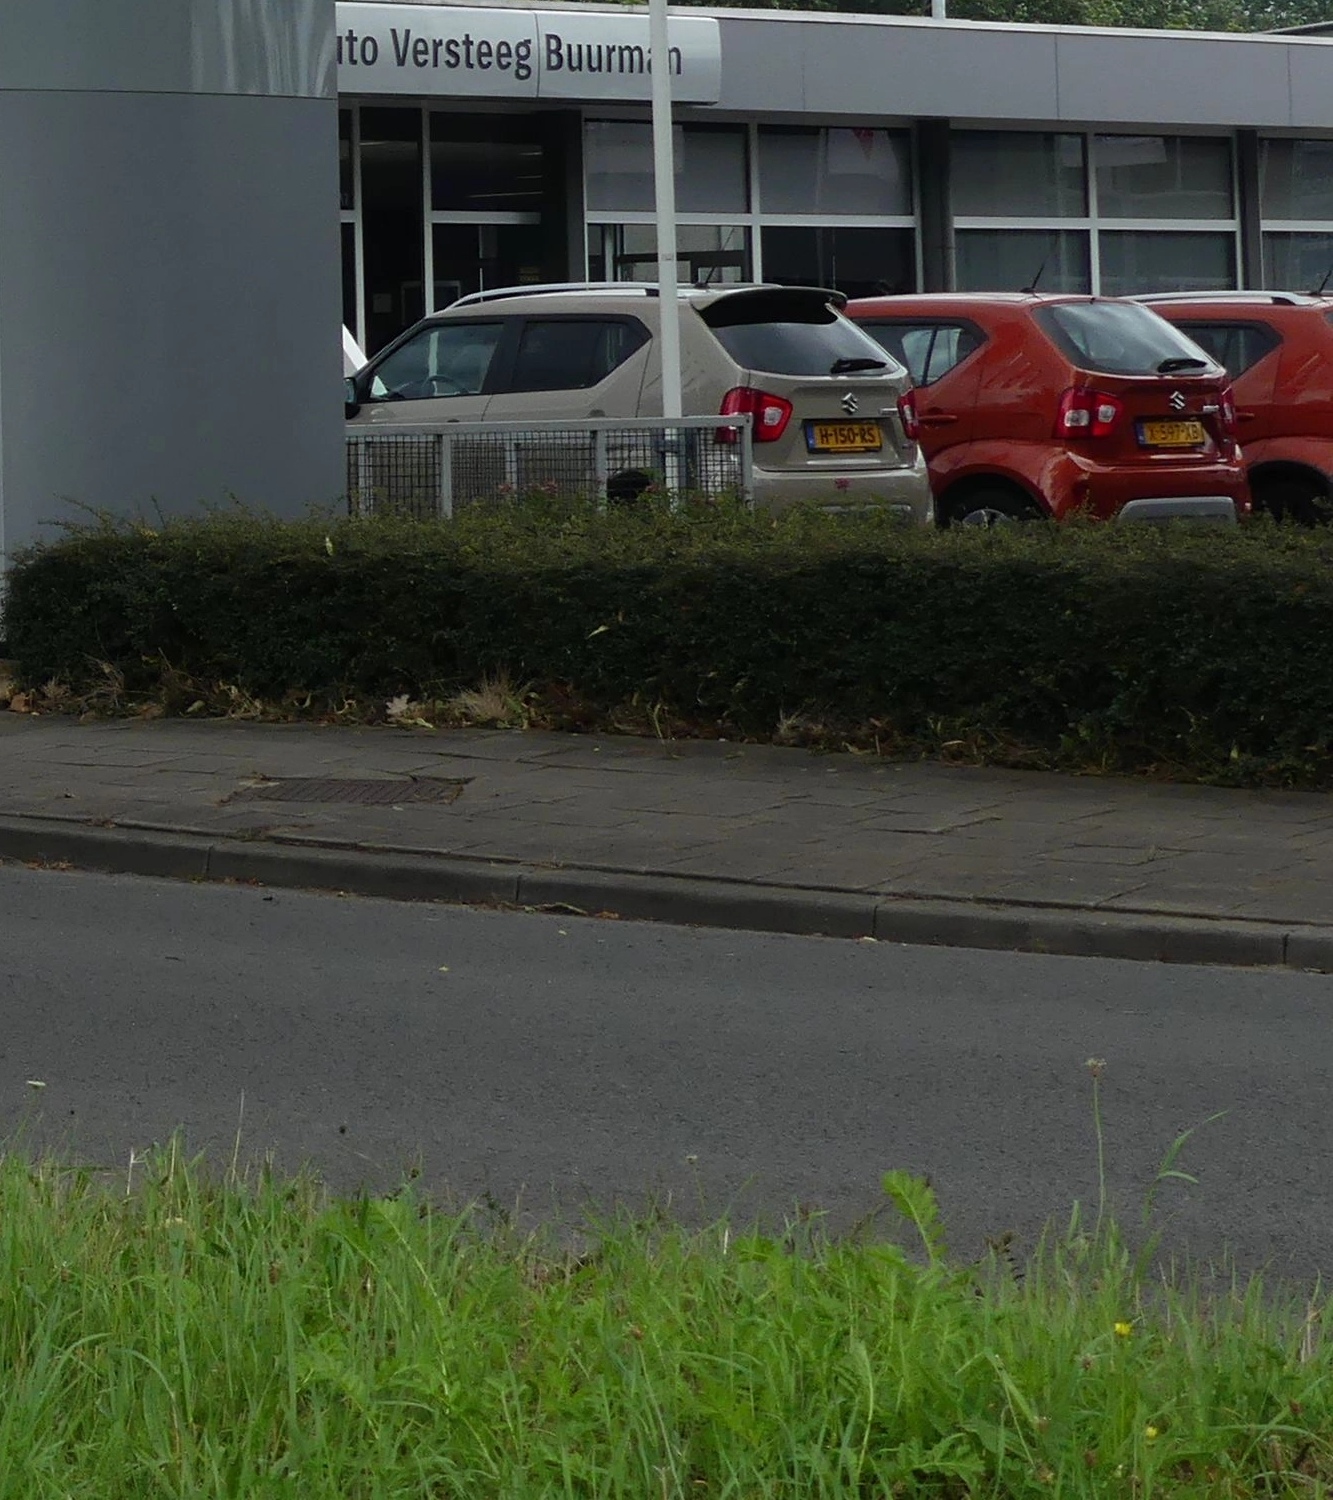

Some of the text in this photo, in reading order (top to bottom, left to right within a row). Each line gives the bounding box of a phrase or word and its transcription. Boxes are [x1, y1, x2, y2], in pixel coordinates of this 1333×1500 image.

[336, 28, 682, 80] to Versteeg Buurmn
[819, 426, 876, 445] H-150-RS
